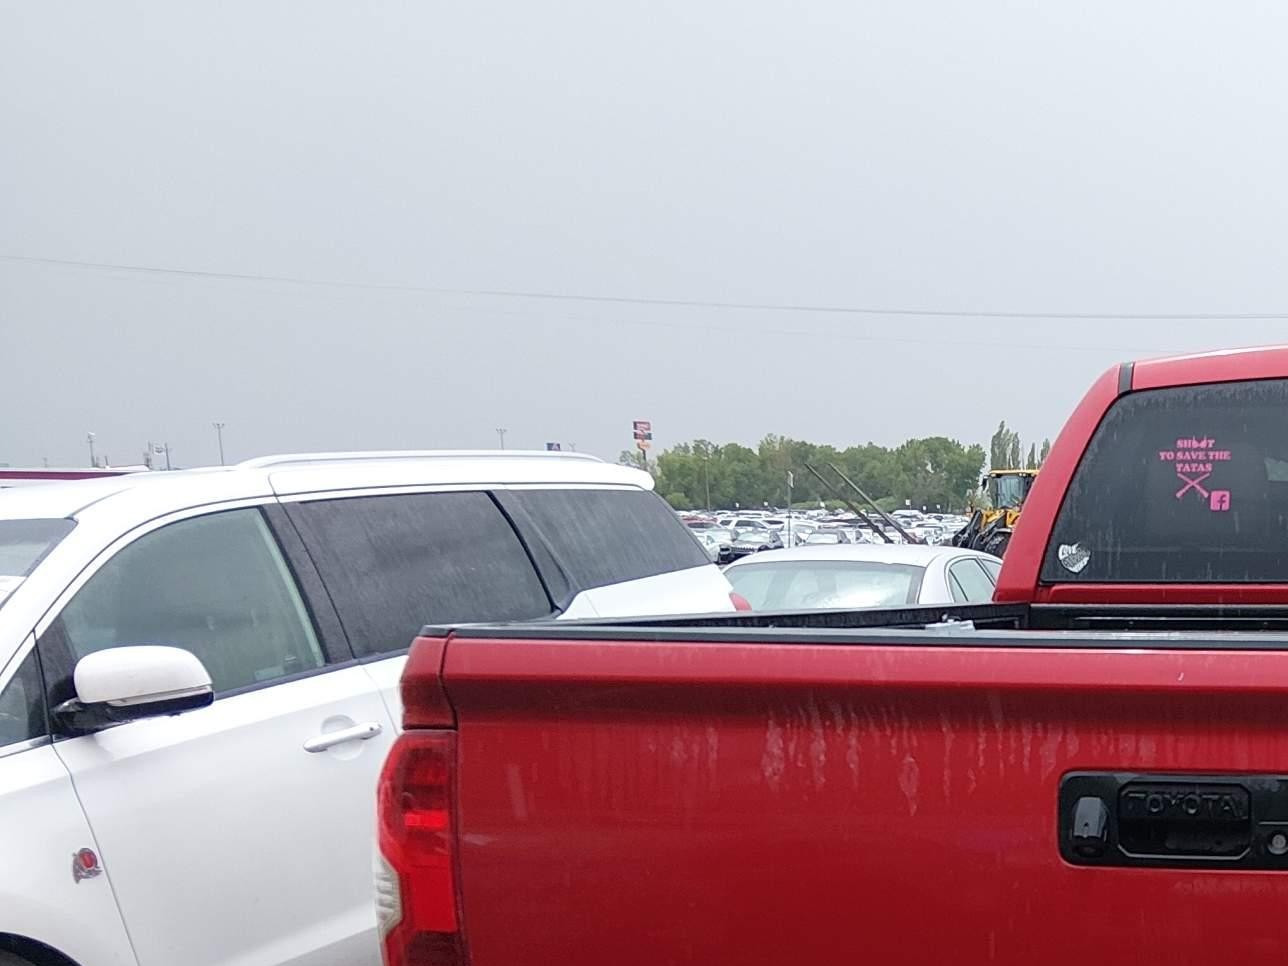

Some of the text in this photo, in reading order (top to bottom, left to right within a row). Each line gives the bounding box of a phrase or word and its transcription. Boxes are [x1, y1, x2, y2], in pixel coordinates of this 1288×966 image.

[1159, 450, 1231, 461] TO SAVE THE
[1175, 462, 1213, 473] TATAS
[1127, 792, 1244, 819] TOYOTA
